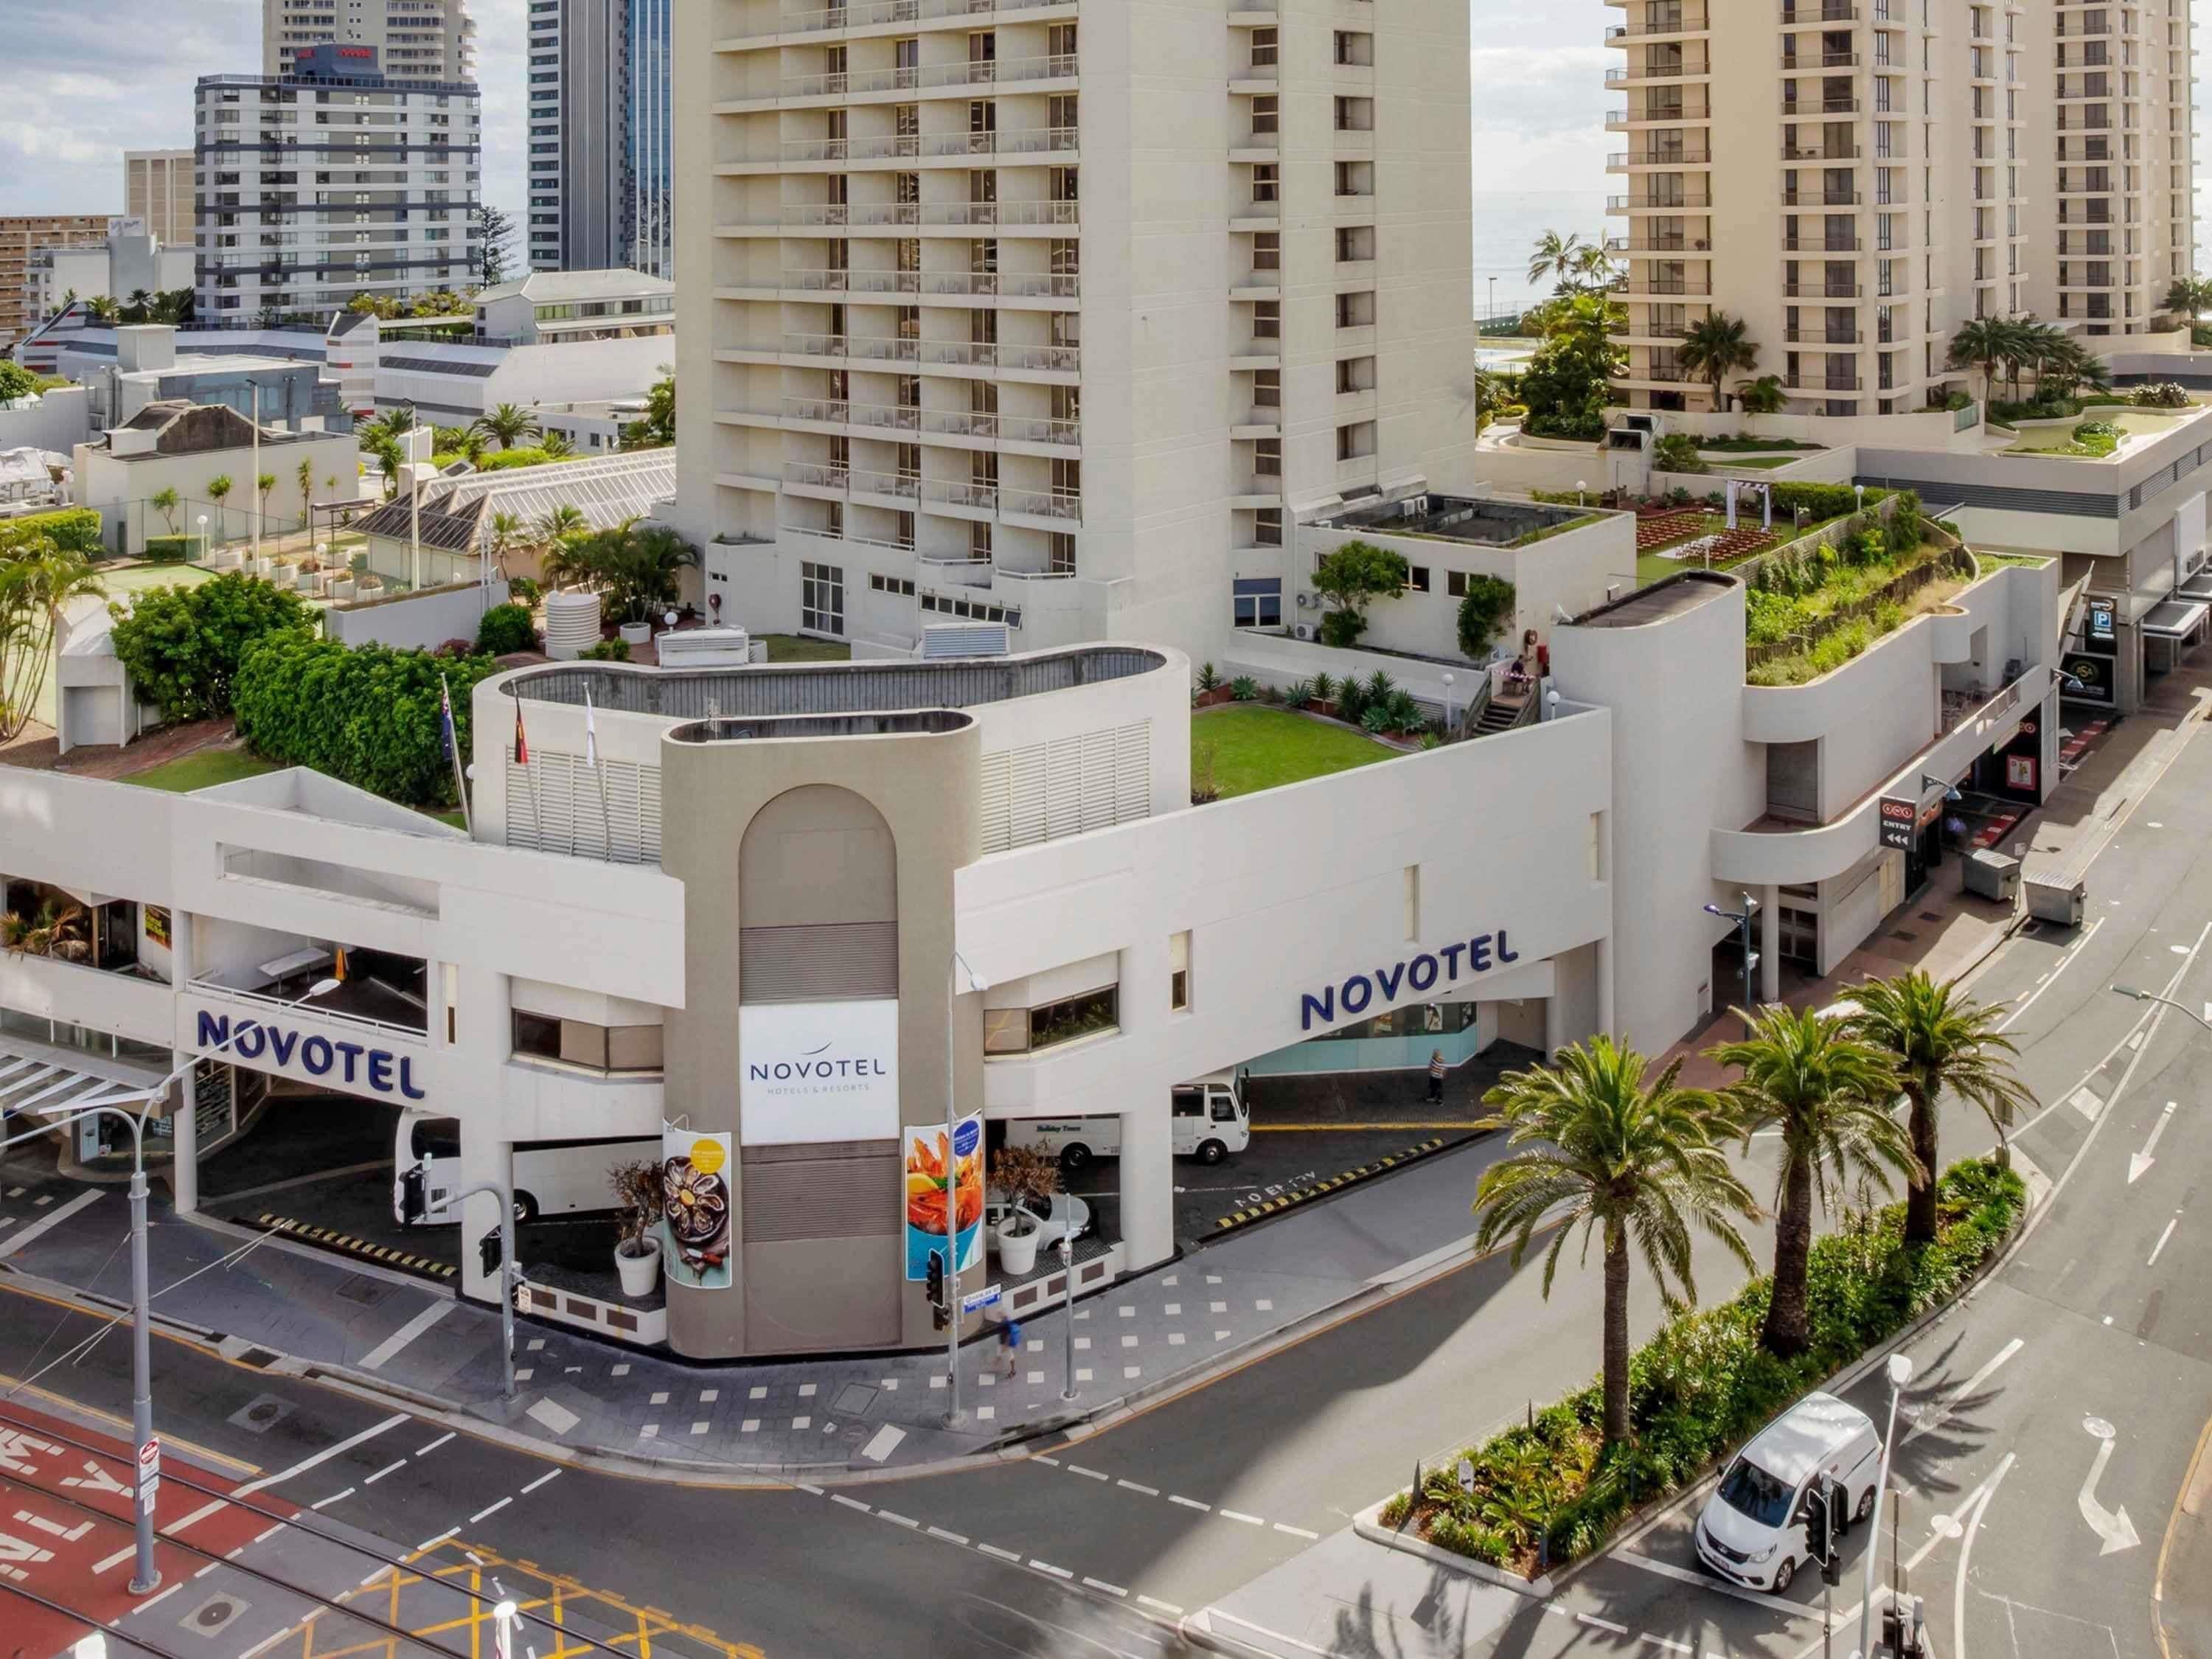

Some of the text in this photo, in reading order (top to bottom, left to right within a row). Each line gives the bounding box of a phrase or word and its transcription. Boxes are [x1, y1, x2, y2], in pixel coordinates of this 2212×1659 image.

[1301, 930, 1519, 1030] NOVOTEL
[198, 1009, 425, 1099] NOVOTEL
[751, 1059, 886, 1081] NOVOTEL
[823, 1083, 869, 1093] RESORTS
[0, 1460, 134, 1582] NLY
